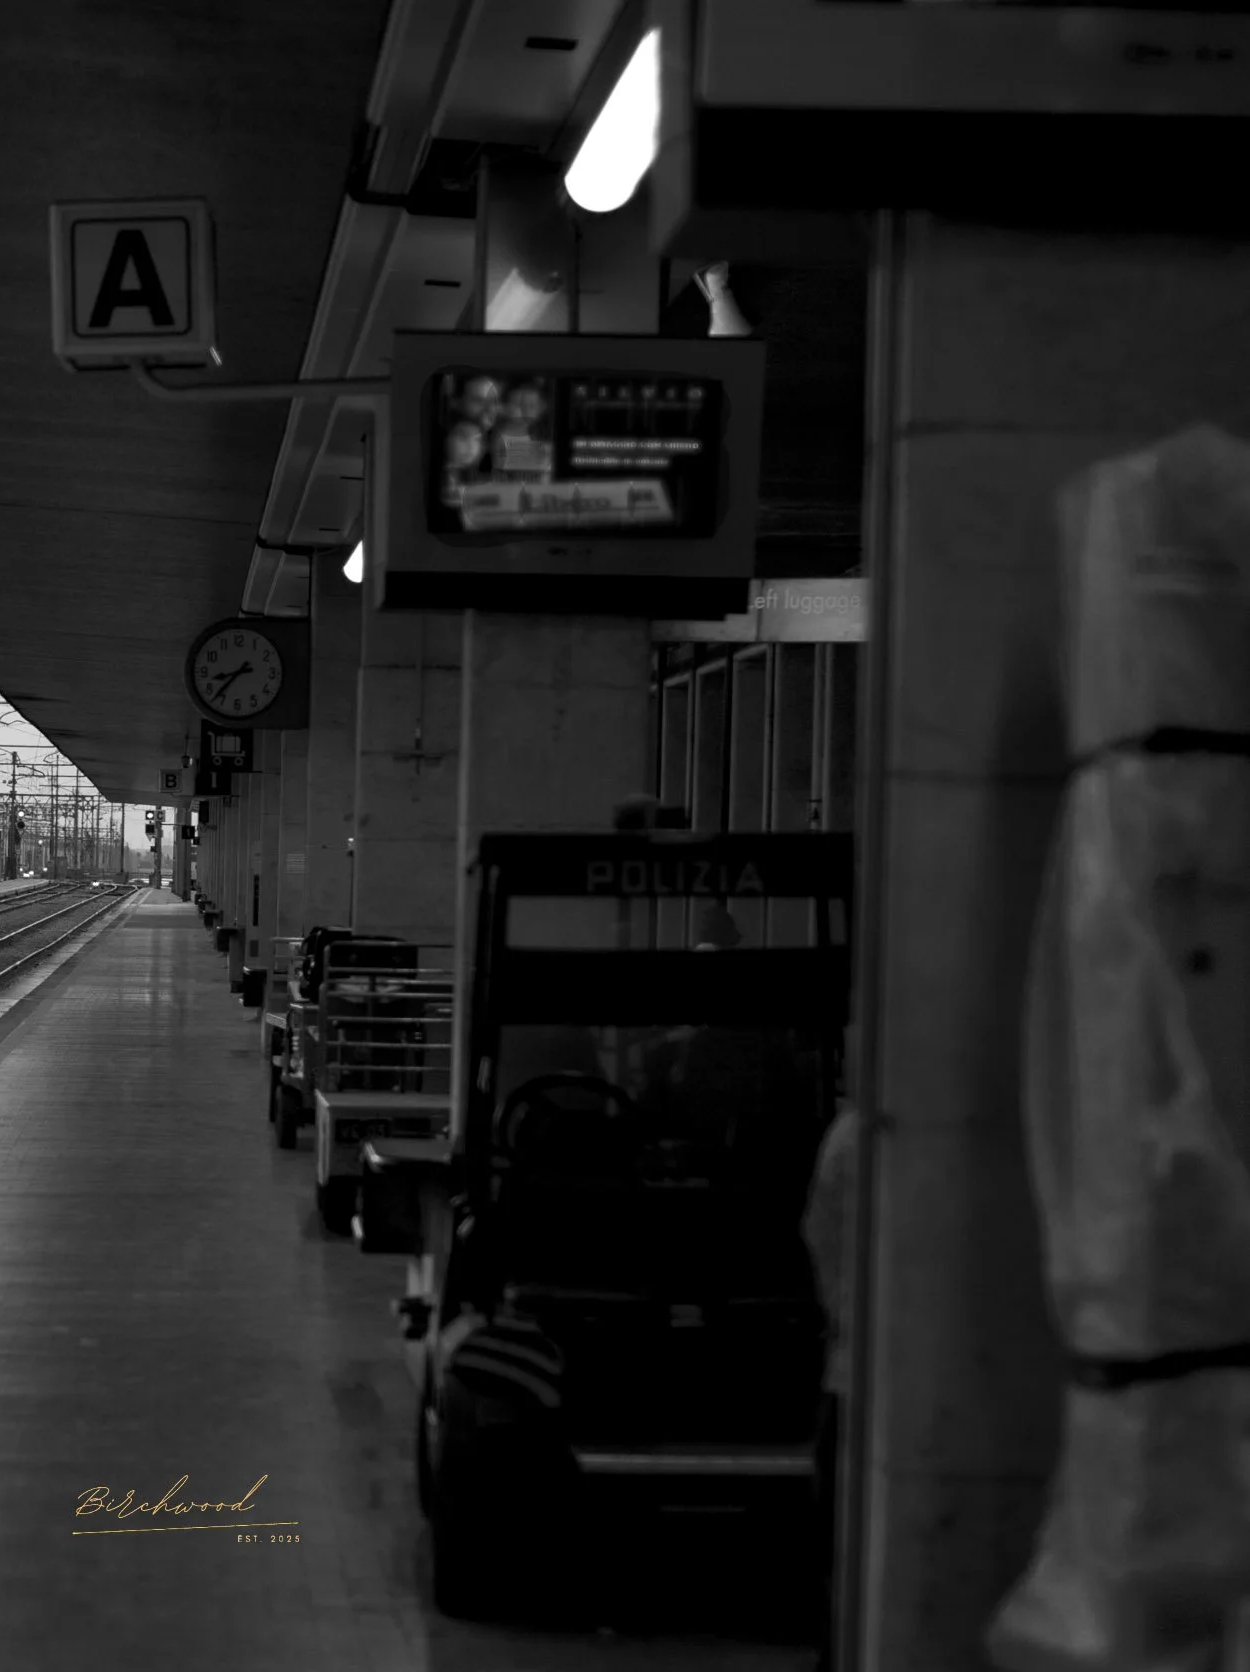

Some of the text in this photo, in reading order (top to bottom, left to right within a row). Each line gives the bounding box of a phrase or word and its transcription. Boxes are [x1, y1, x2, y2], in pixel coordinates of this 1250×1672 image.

[88, 229, 175, 328] A
[748, 588, 860, 615] eft luggage
[220, 639, 228, 651] 11
[234, 634, 245, 648] 12
[207, 650, 218, 663] 10
[263, 649, 270, 662] 2
[200, 665, 208, 678] 9
[269, 667, 276, 680] 3
[206, 683, 213, 695] 8
[262, 683, 270, 694] 4
[218, 693, 226, 706] 7
[234, 698, 241, 710] 6
[250, 694, 258, 707] 5
[165, 773, 177, 788] B
[156, 811, 163, 820] C
[585, 858, 766, 894] POLIZIA
